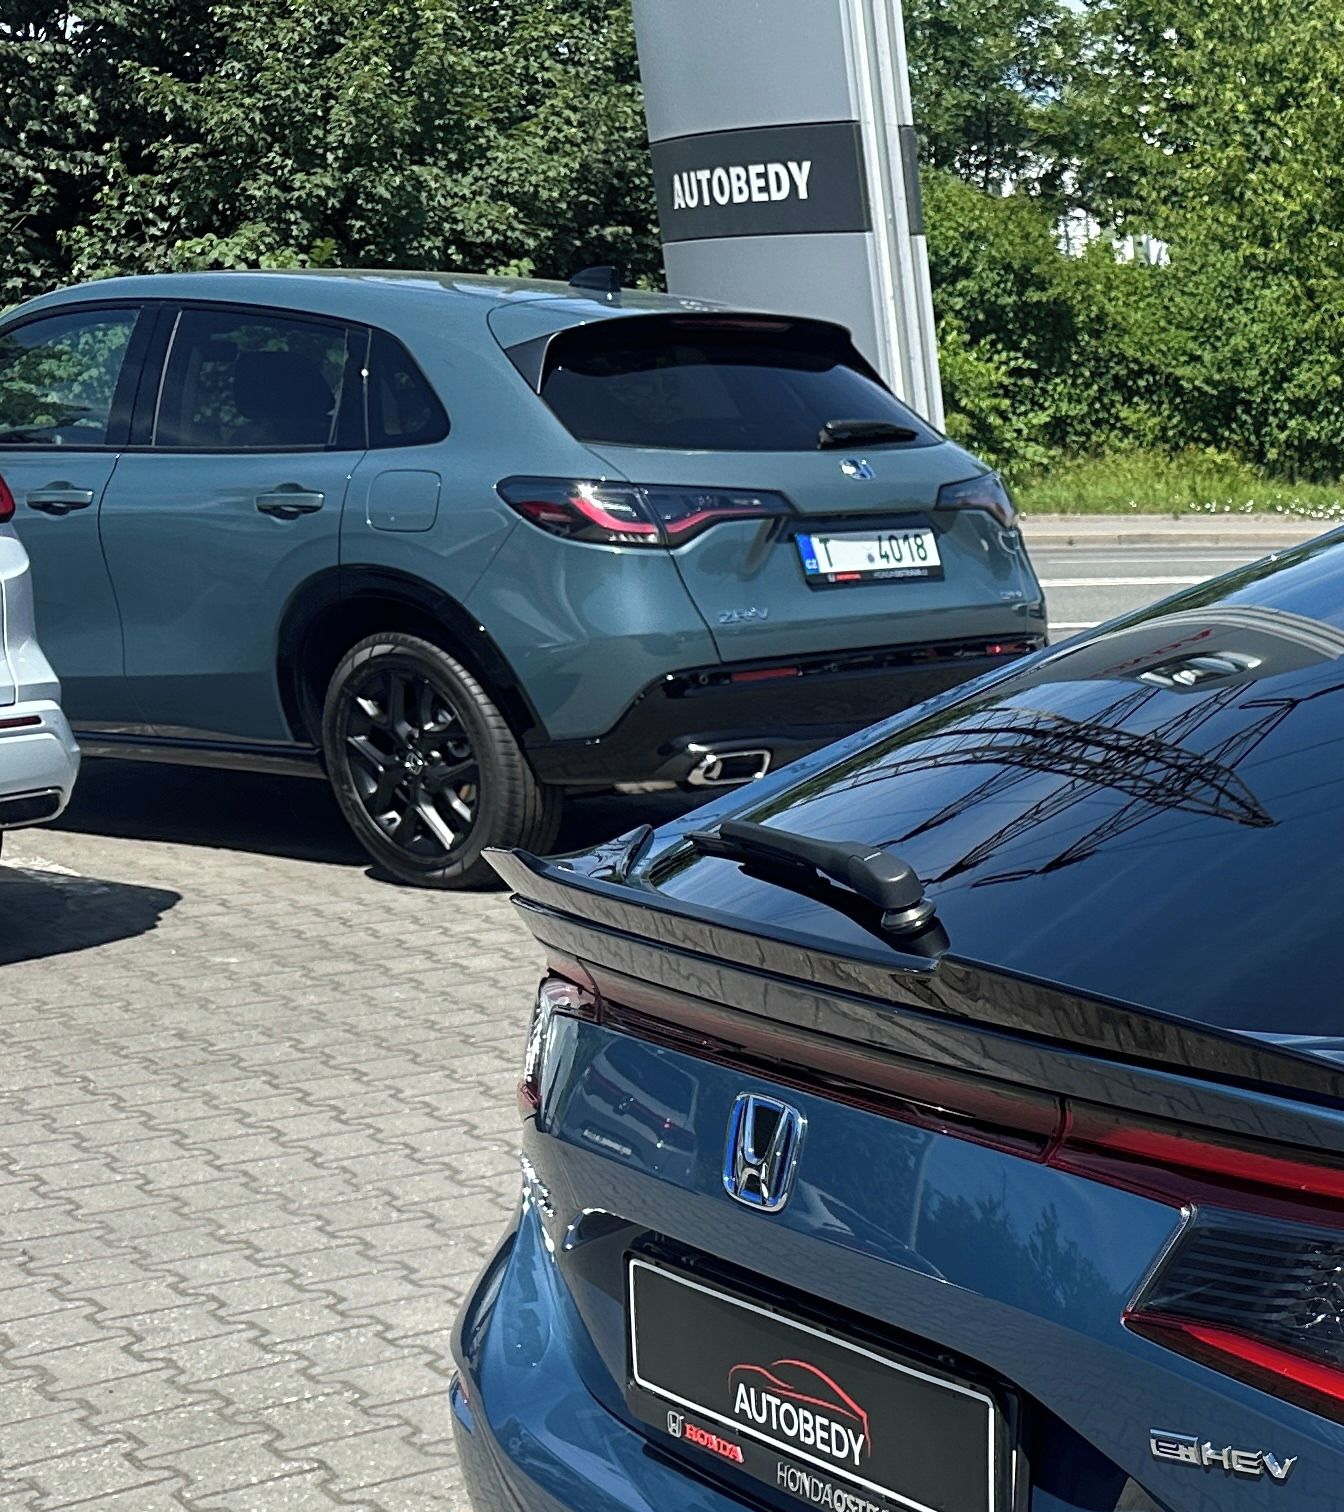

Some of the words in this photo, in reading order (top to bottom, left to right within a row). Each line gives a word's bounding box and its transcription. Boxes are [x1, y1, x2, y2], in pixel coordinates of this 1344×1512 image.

[672, 160, 812, 210] AUTOBEDY
[877, 534, 928, 564] 4018
[684, 1423, 744, 1464] HONDA
[734, 1382, 865, 1466] AUTOBEDY
